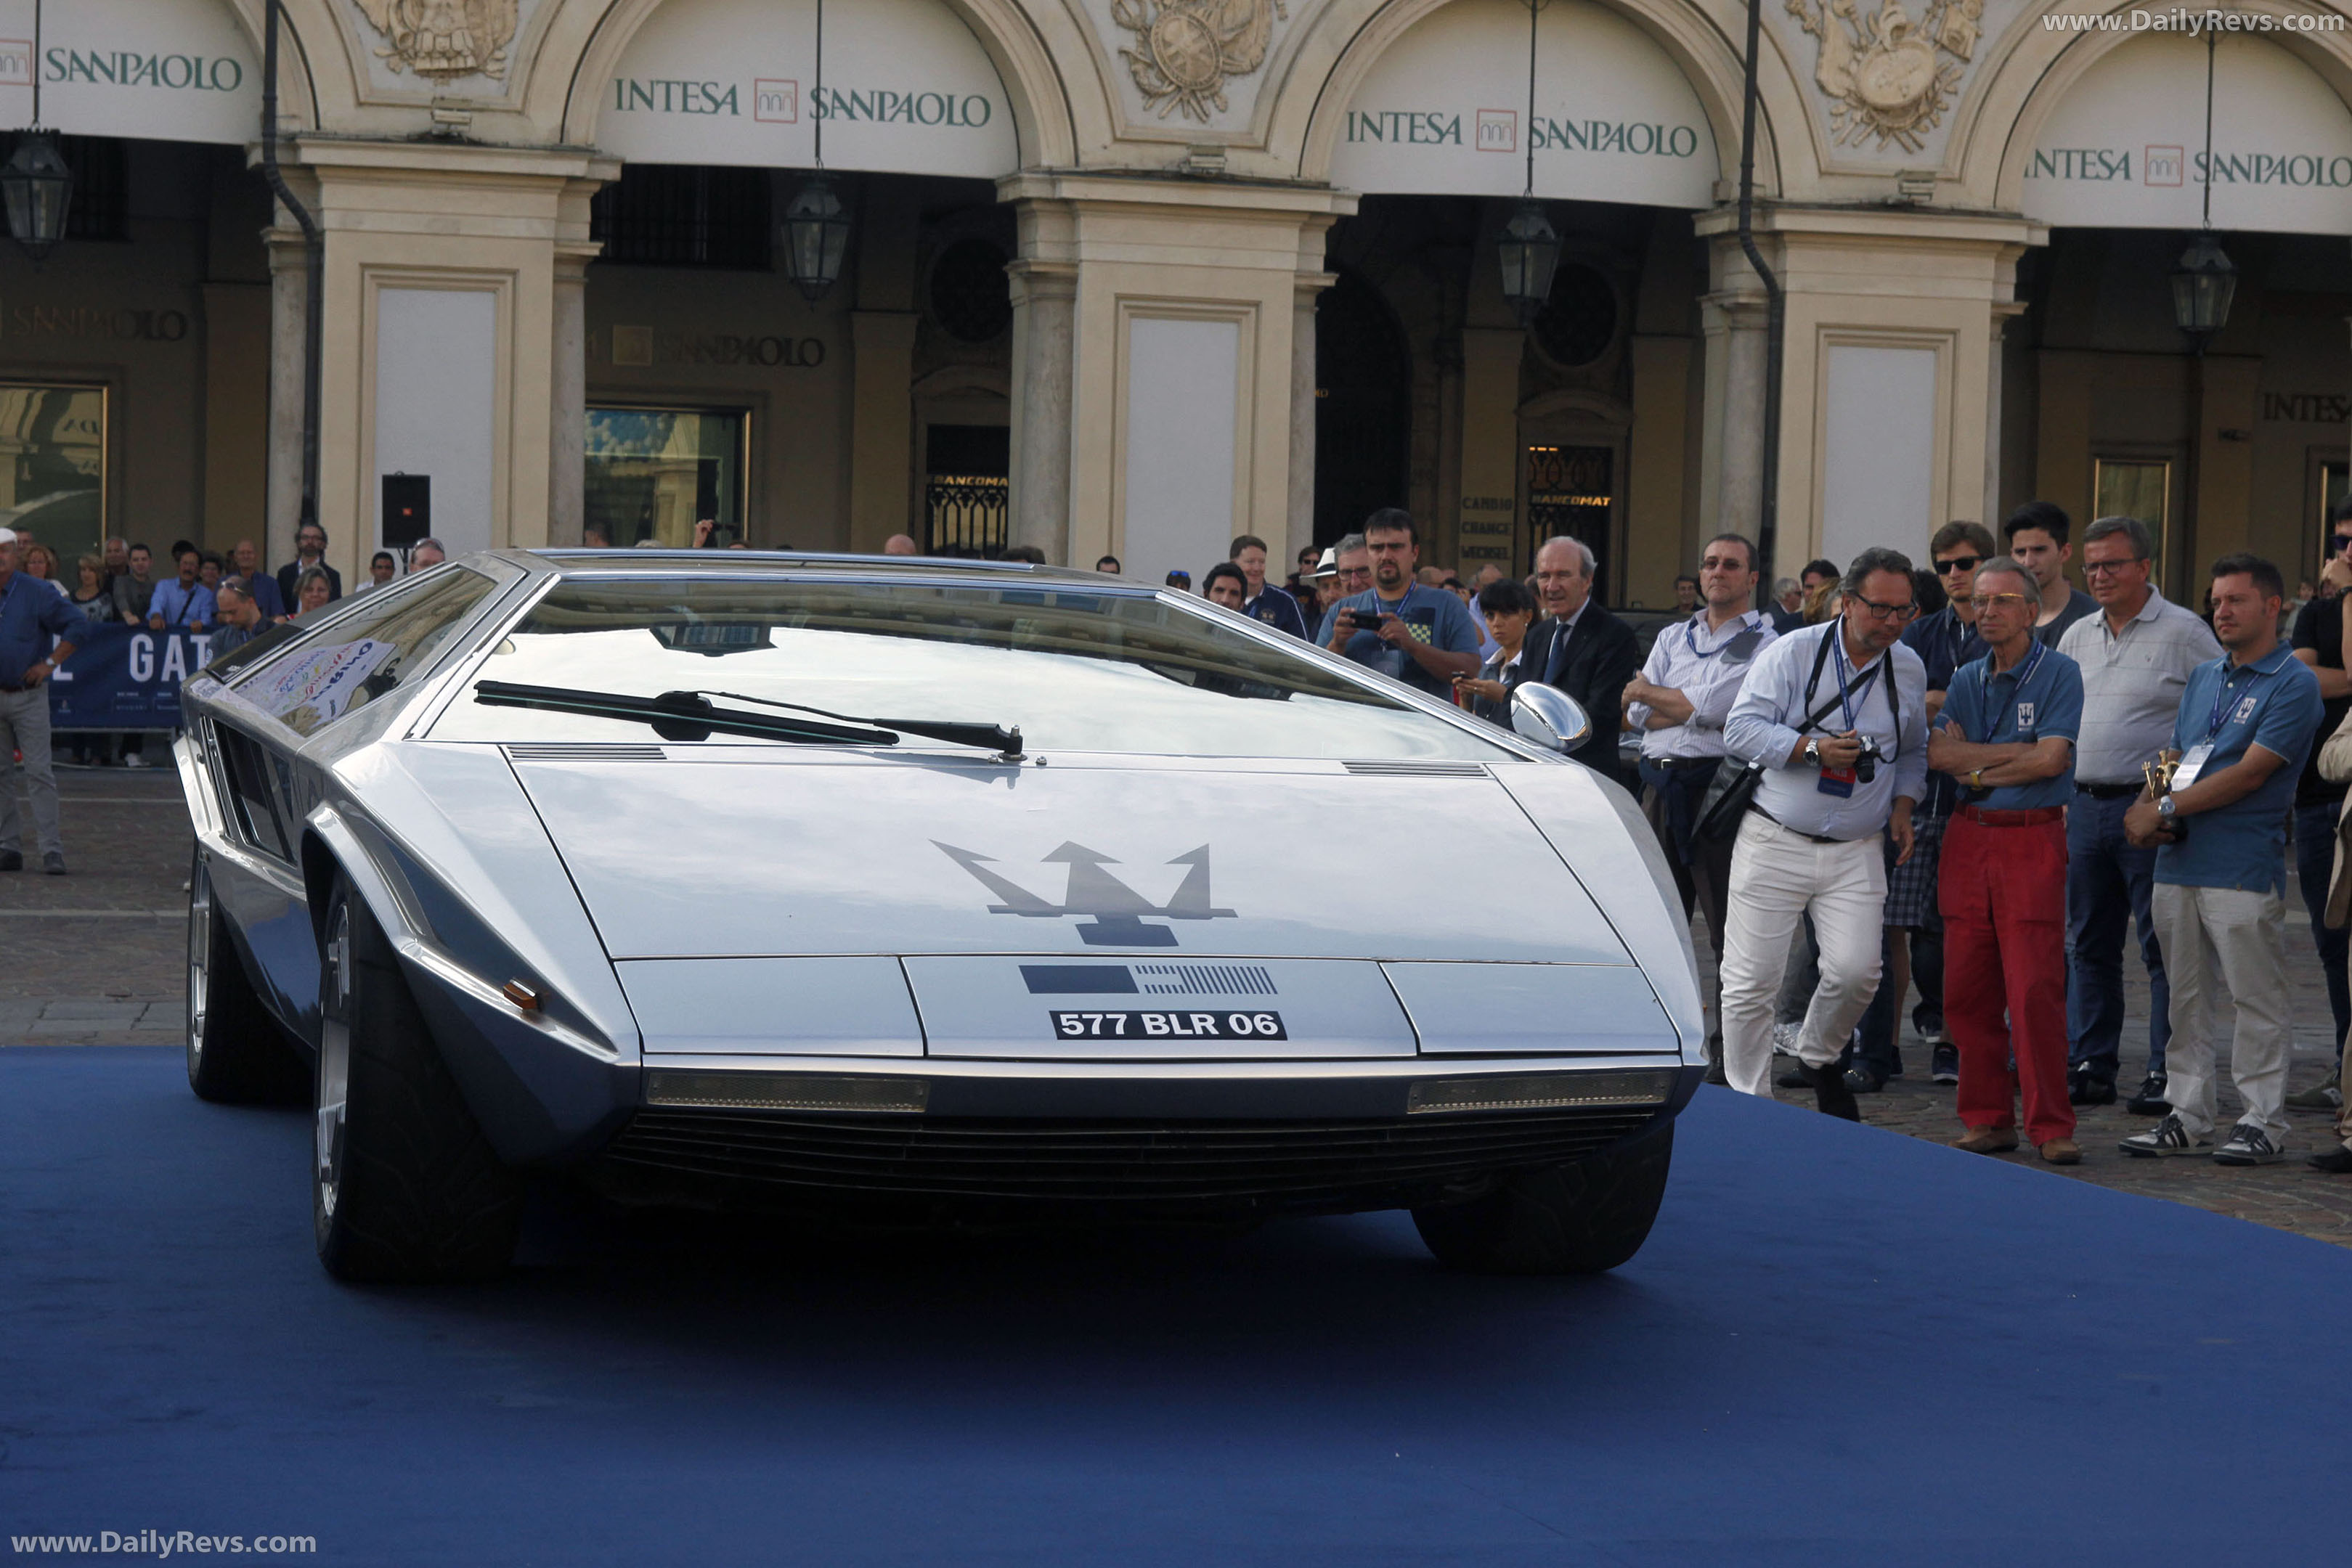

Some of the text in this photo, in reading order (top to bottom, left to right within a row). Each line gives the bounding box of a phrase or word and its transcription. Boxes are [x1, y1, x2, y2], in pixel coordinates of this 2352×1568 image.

[46, 47, 243, 92] SANPAOLO
[614, 78, 991, 128] INTESA SANPAOLO
[1347, 112, 1698, 158] INTESA SANPAOLO
[2193, 151, 2352, 187] SANPAOLO
[1462, 497, 1513, 510] CAMBIO
[1531, 494, 1611, 507] BANCOMAT
[1059, 1013, 1278, 1036] 577 BLR 06
